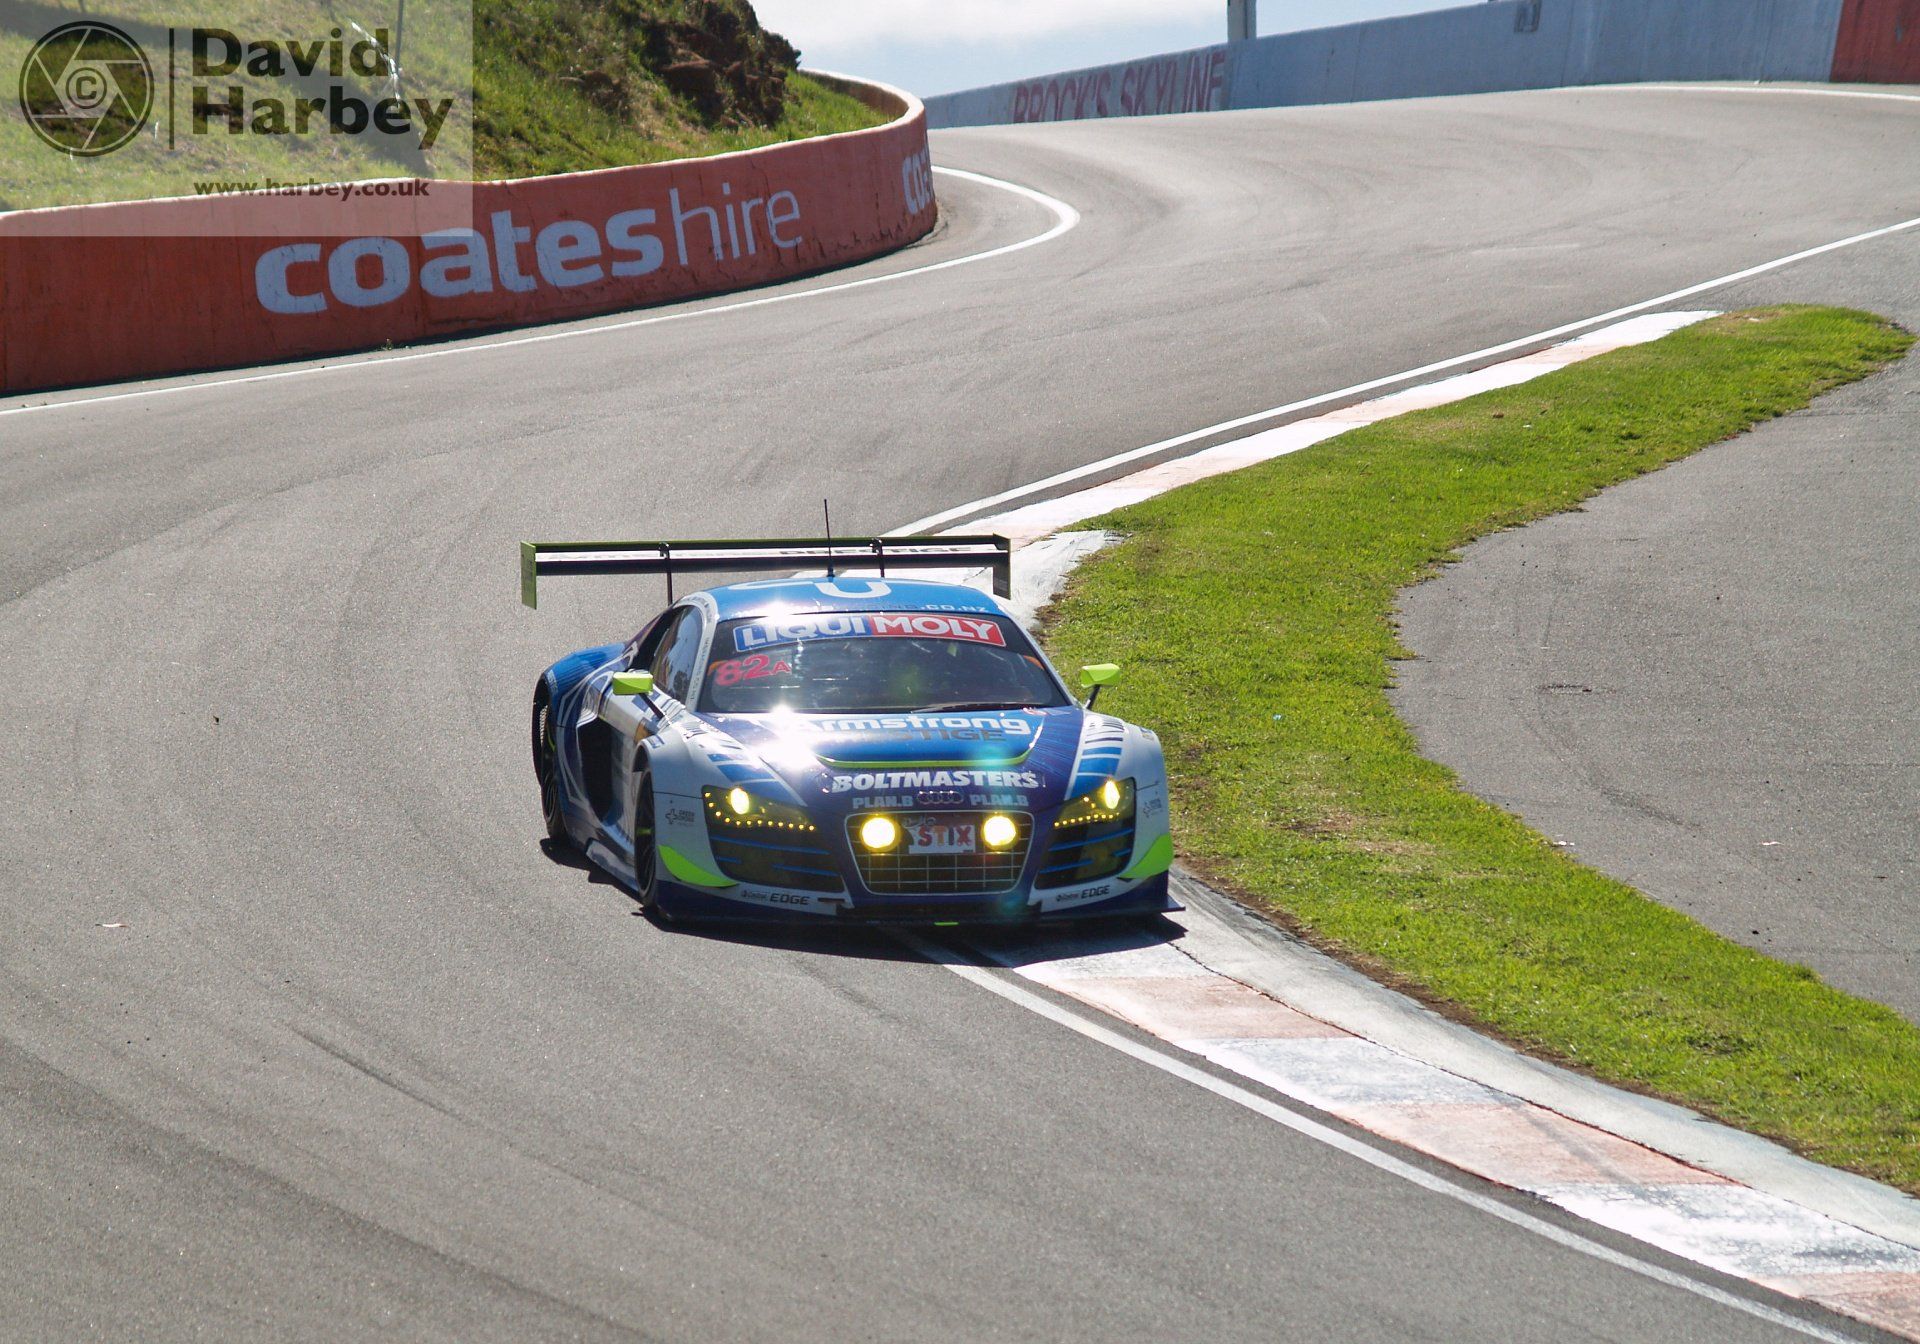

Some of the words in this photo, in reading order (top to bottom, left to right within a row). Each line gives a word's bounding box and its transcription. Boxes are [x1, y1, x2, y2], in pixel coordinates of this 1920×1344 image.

[742, 614, 868, 647] LIQUI
[873, 616, 997, 640] MOLY
[715, 653, 793, 687] 82A
[831, 770, 1039, 794] BOLTMASTERS
[917, 824, 972, 847] STIX
[770, 893, 811, 905] EDGE
[1080, 884, 1111, 899] EDGE
